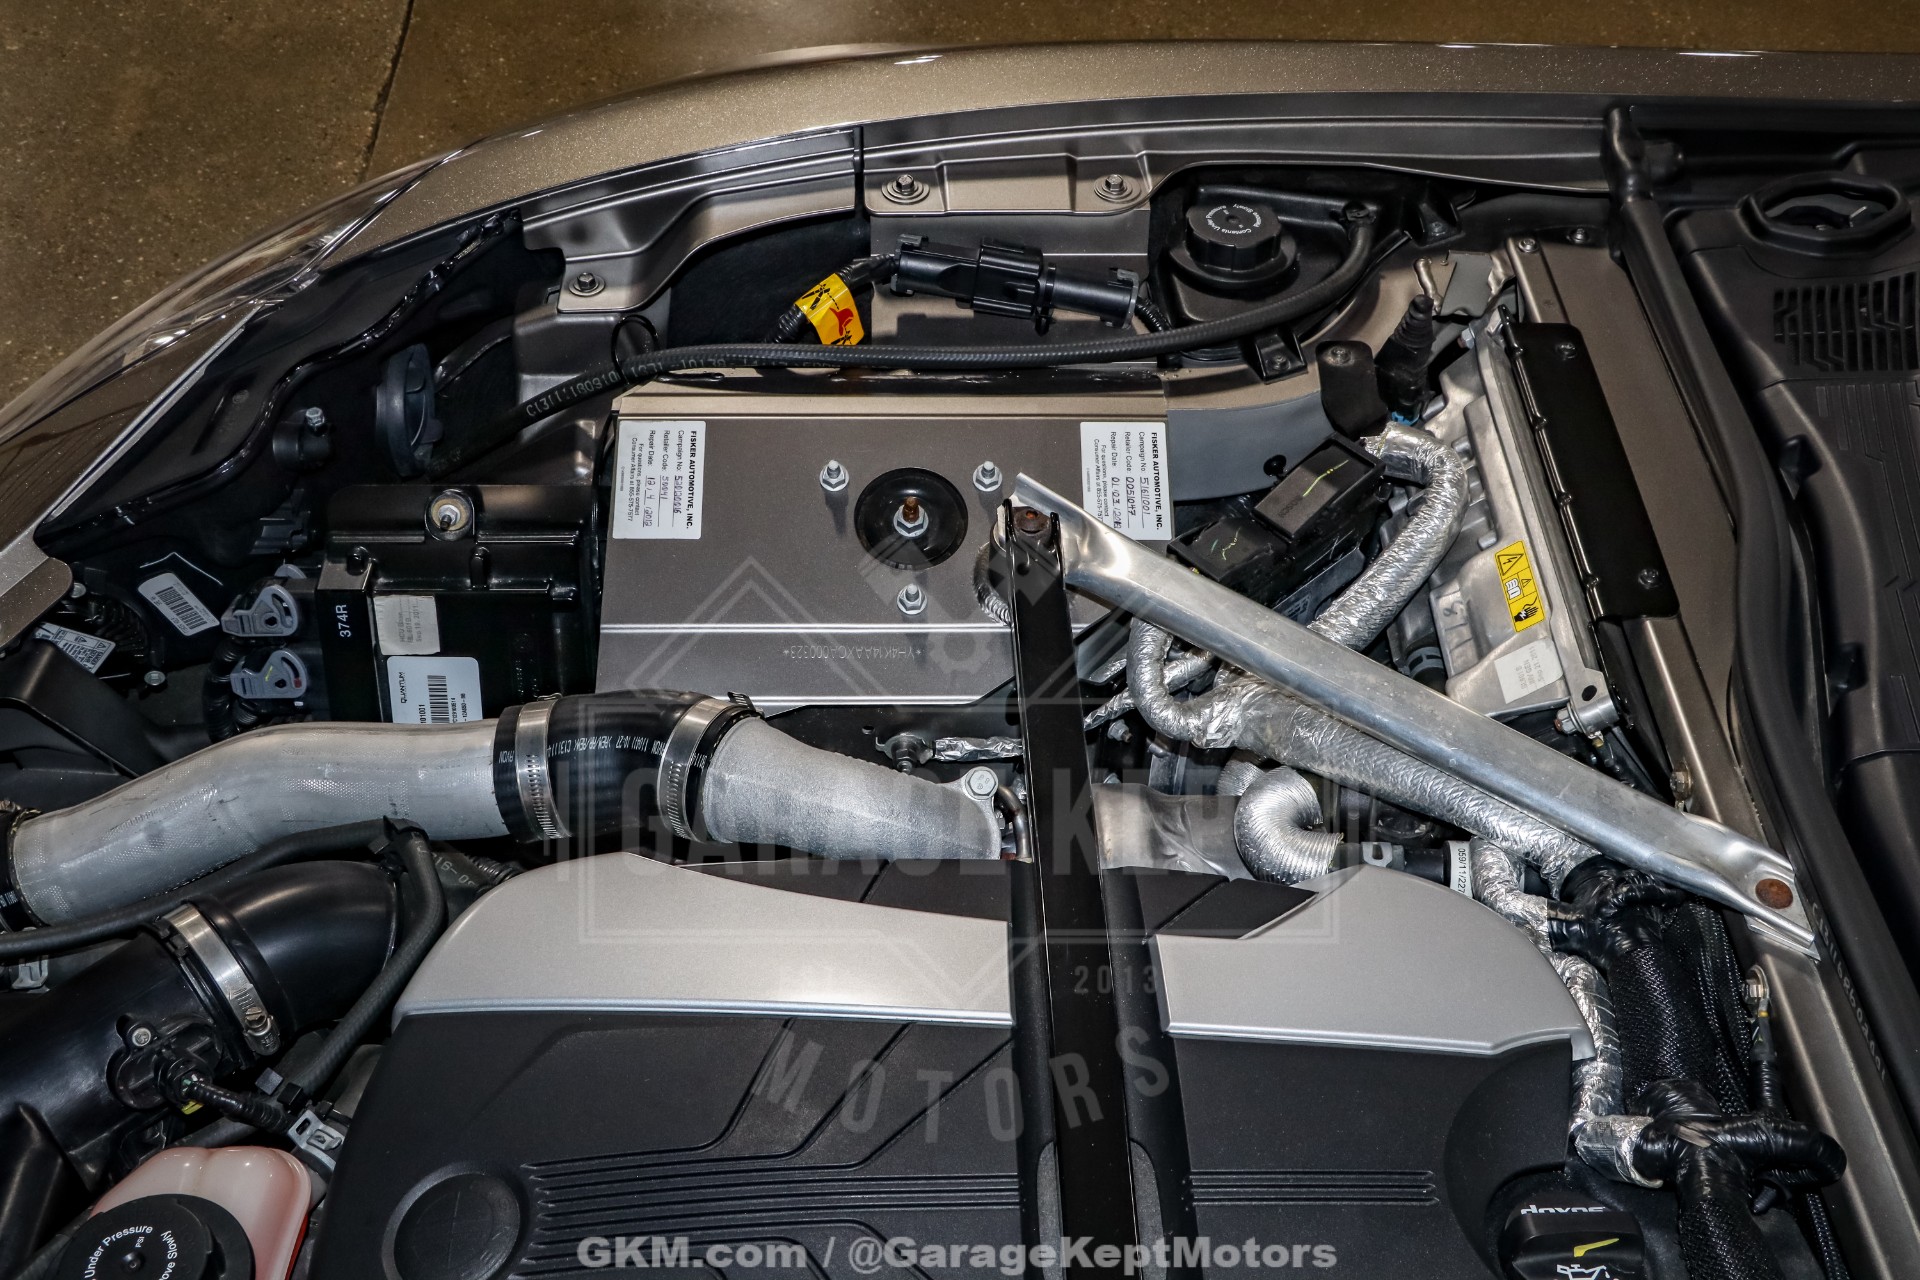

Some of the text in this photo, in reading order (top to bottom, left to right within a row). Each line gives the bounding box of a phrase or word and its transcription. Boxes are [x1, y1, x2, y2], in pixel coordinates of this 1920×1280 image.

[648, 429, 656, 450] Repair
[675, 429, 684, 460] Campaign
[1138, 431, 1146, 460] Campaign
[1151, 432, 1159, 459] FISKER
[686, 459, 696, 511] AUTOMOTIVE,
[1152, 460, 1161, 513] AUTOMOTIVE,
[335, 604, 352, 638] 374R
[398, 671, 407, 704] QUANTUM
[84, 1225, 154, 1279] Under Pressure
[135, 1236, 145, 1248] PSI
[160, 1230, 178, 1260] Slowly
